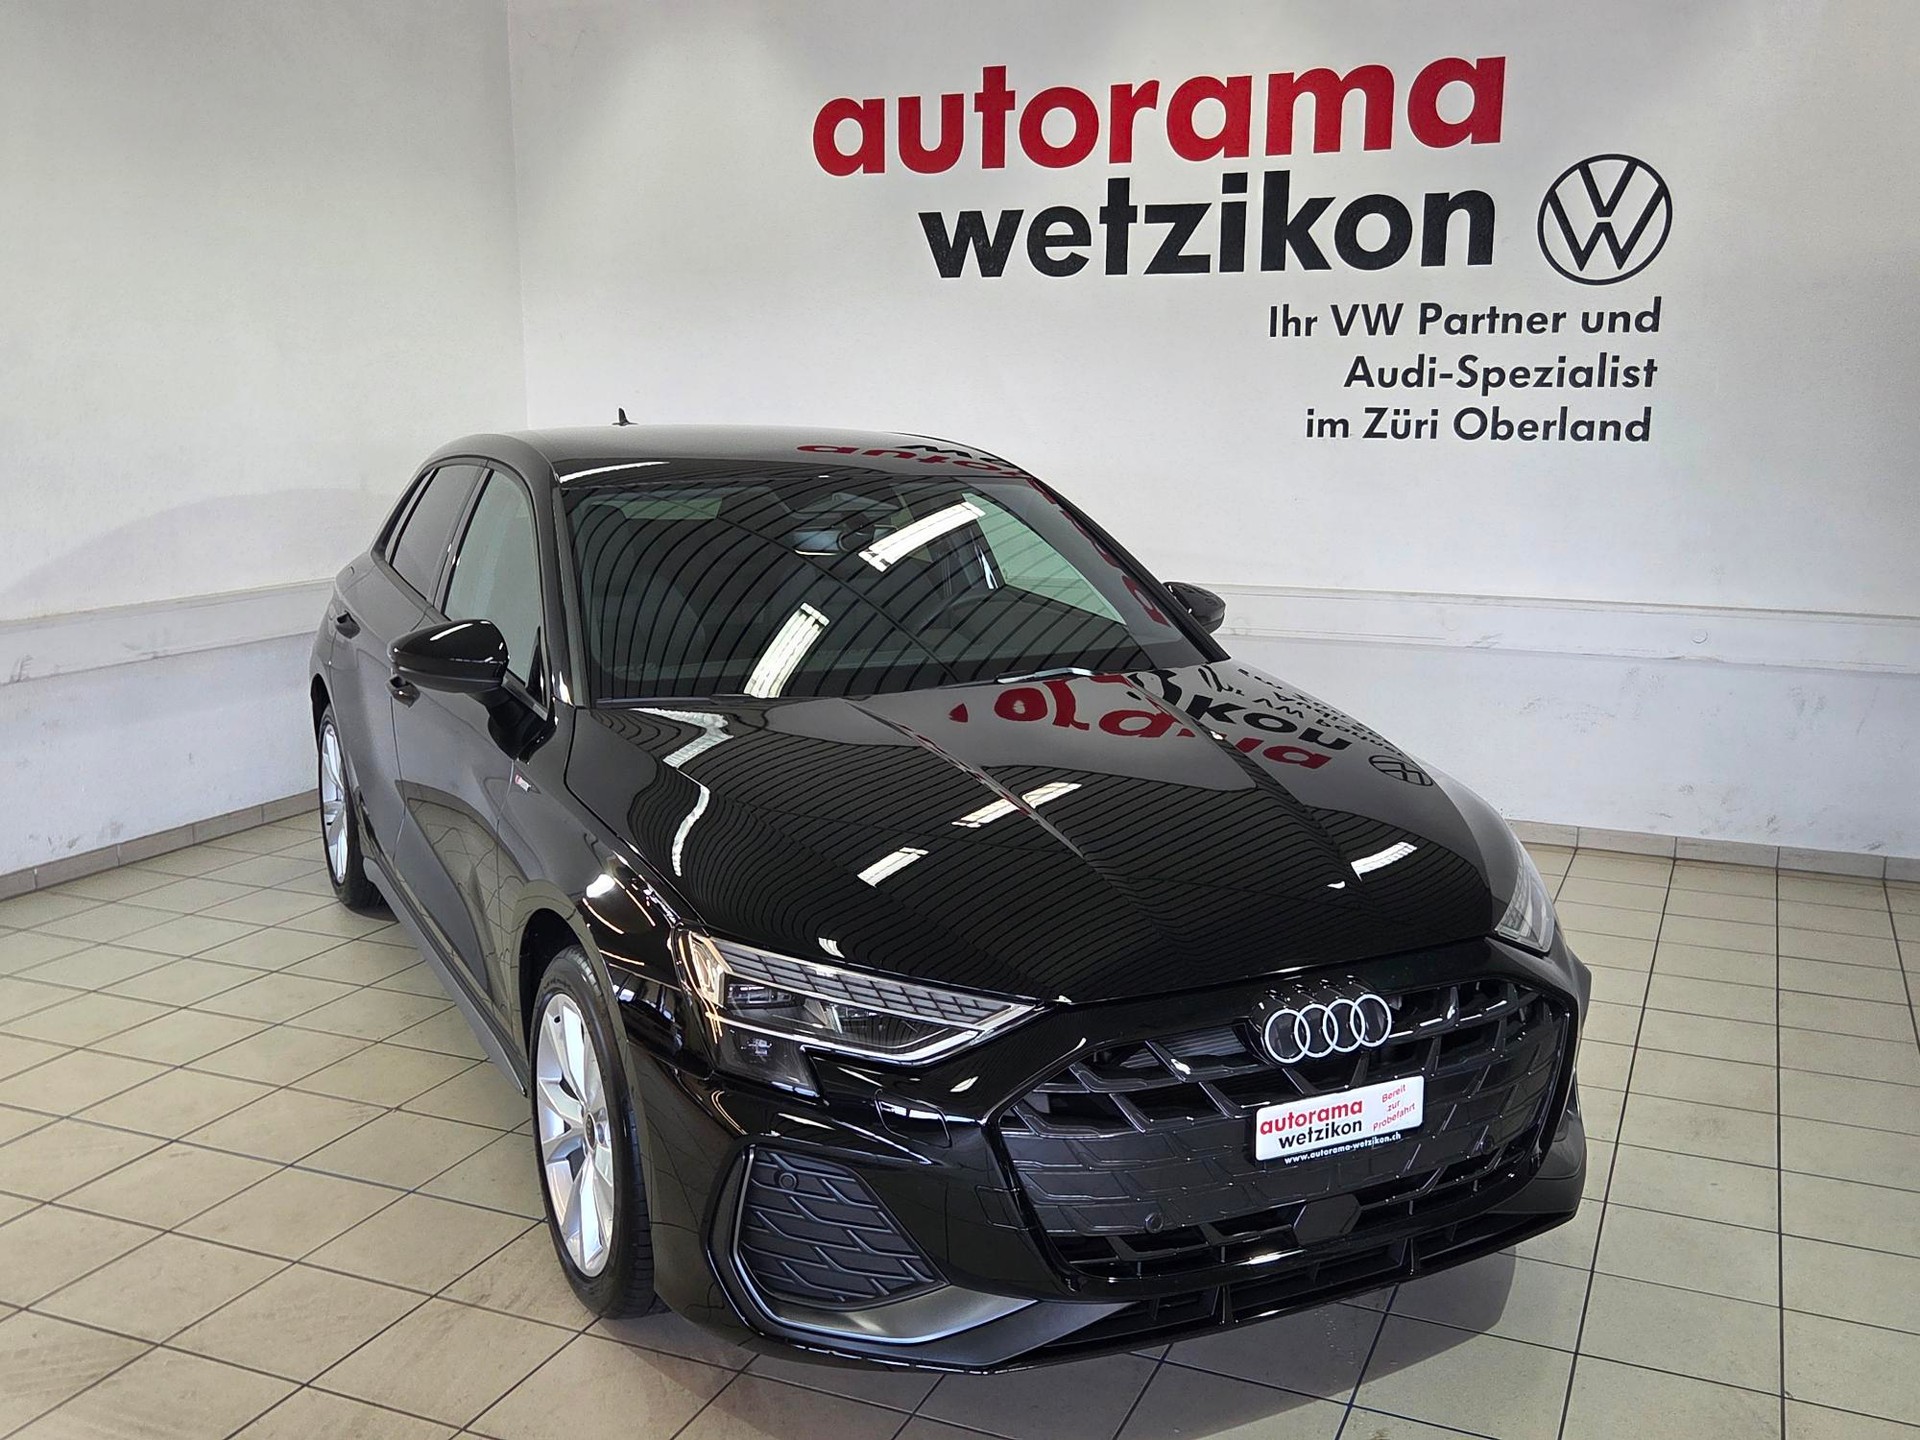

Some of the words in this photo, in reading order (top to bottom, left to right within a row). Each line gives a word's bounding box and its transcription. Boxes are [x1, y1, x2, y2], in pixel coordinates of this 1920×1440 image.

[813, 56, 1506, 177] autorama
[917, 170, 1496, 279] wetzikon
[1268, 303, 1318, 338] Ihr
[1331, 302, 1404, 337] VW
[1418, 302, 1568, 335] Partner
[1581, 296, 1662, 334] und
[1343, 351, 1659, 397] Audi-Spezialist
[1306, 408, 1349, 439] im
[1362, 406, 1439, 441] Züri
[1453, 405, 1653, 442] Oberland
[1381, 1083, 1407, 1104] Bereit
[1386, 1099, 1401, 1112] zur
[1260, 1100, 1364, 1136] autorama
[1278, 1120, 1363, 1149] wetzikon
[1372, 1102, 1416, 1131] Probefahrt
[1284, 1131, 1402, 1165] www.autorama-wetzikon.ch
